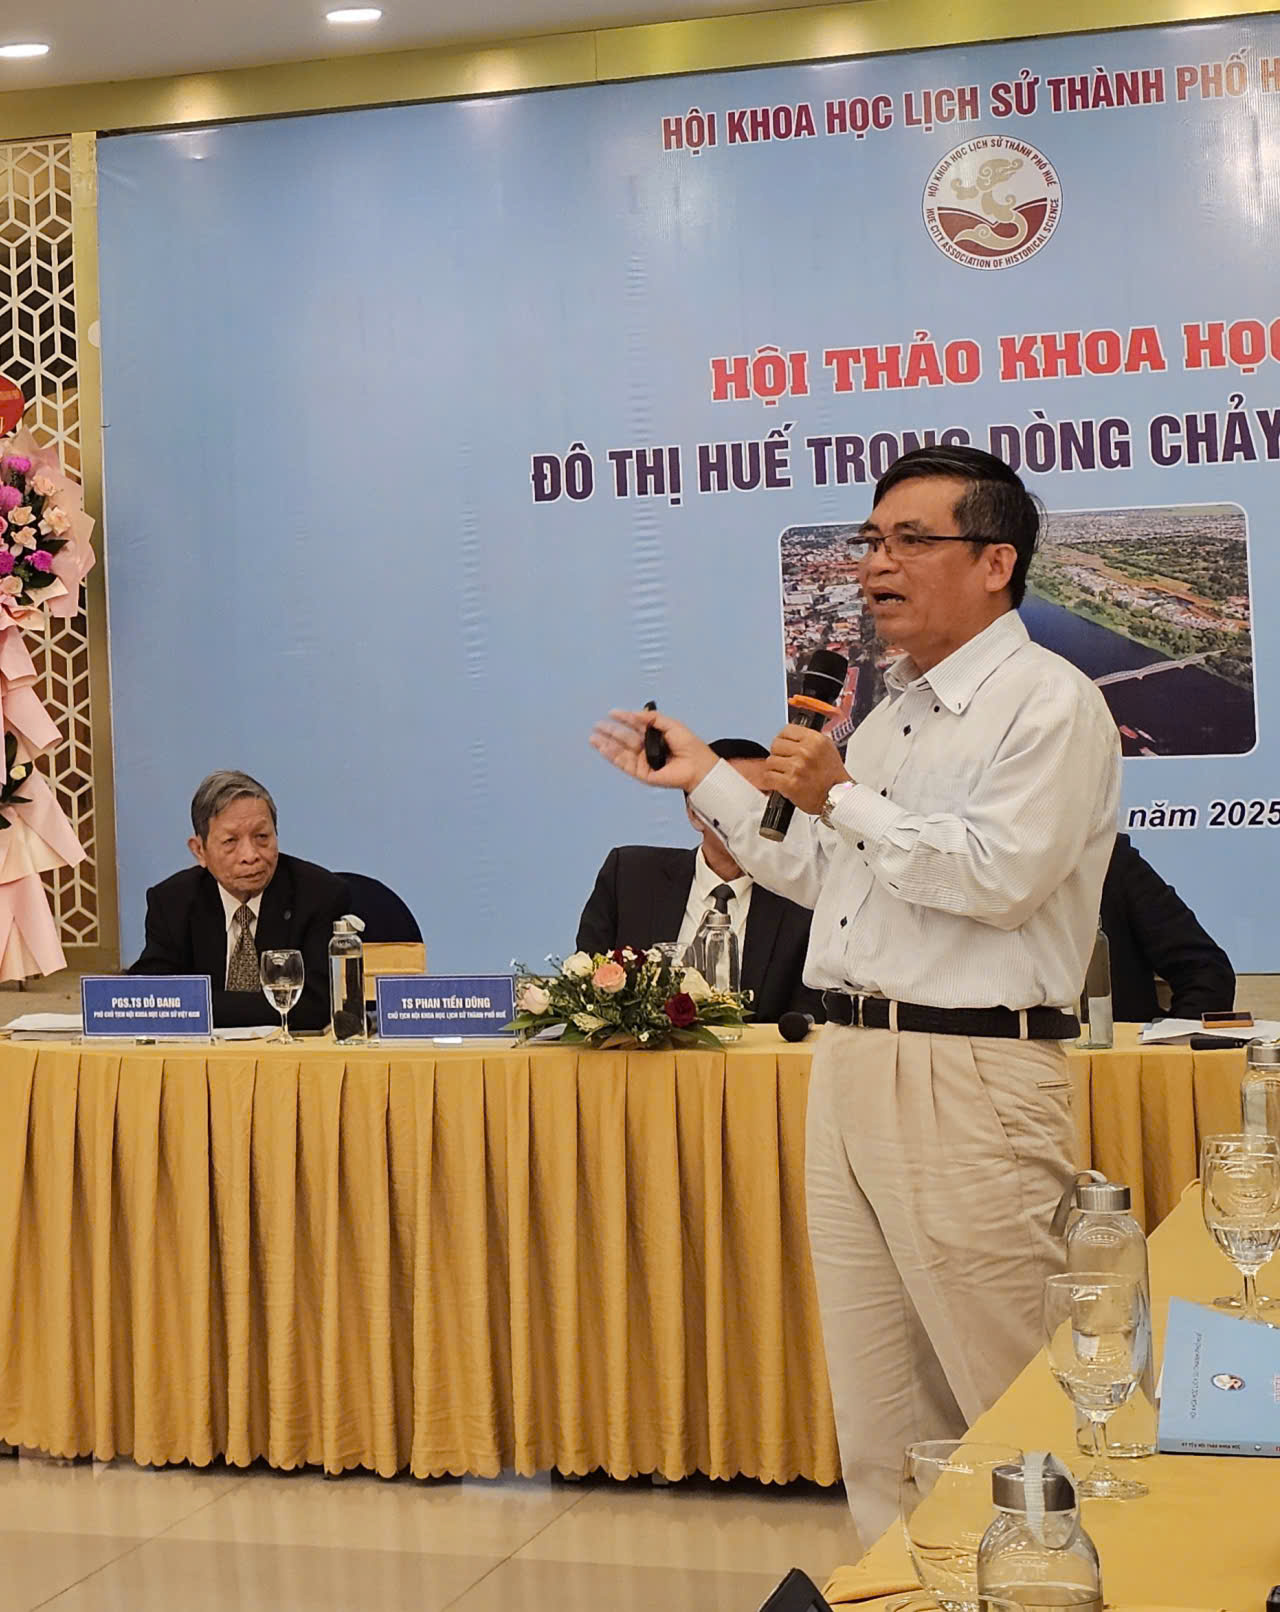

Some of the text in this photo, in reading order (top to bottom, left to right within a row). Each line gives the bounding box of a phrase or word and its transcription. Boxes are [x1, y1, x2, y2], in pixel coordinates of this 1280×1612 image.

[662, 112, 716, 156] HỘI
[726, 104, 816, 145] KHOA
[826, 97, 893, 140] HỌC
[904, 88, 980, 132] LỊCH
[992, 69, 1040, 118] SỬ
[1048, 66, 1165, 111] THÀNH
[1177, 46, 1249, 100] PHỐ
[928, 183, 940, 197] HỘI
[936, 160, 952, 182] KHOA
[950, 147, 968, 162] HỌC
[968, 140, 988, 152] LỊCH
[991, 136, 1004, 148] SỬ
[1005, 140, 1032, 158] THÀNH
[926, 198, 1059, 268] HUE CITY ASSOCIATION OF HISTORICAL SCIENCE
[710, 317, 1280, 407] HỘI THẢO KHOA HỌ
[531, 442, 595, 504] ĐÔ
[608, 445, 683, 506] THỊ
[698, 421, 798, 494] HUẾ
[990, 409, 1133, 476] DÒNG
[1149, 392, 1280, 467] CHẢY
[1128, 800, 1280, 828] năm 2025
[402, 998, 414, 1008] TS
[416, 998, 440, 1008] PHAN
